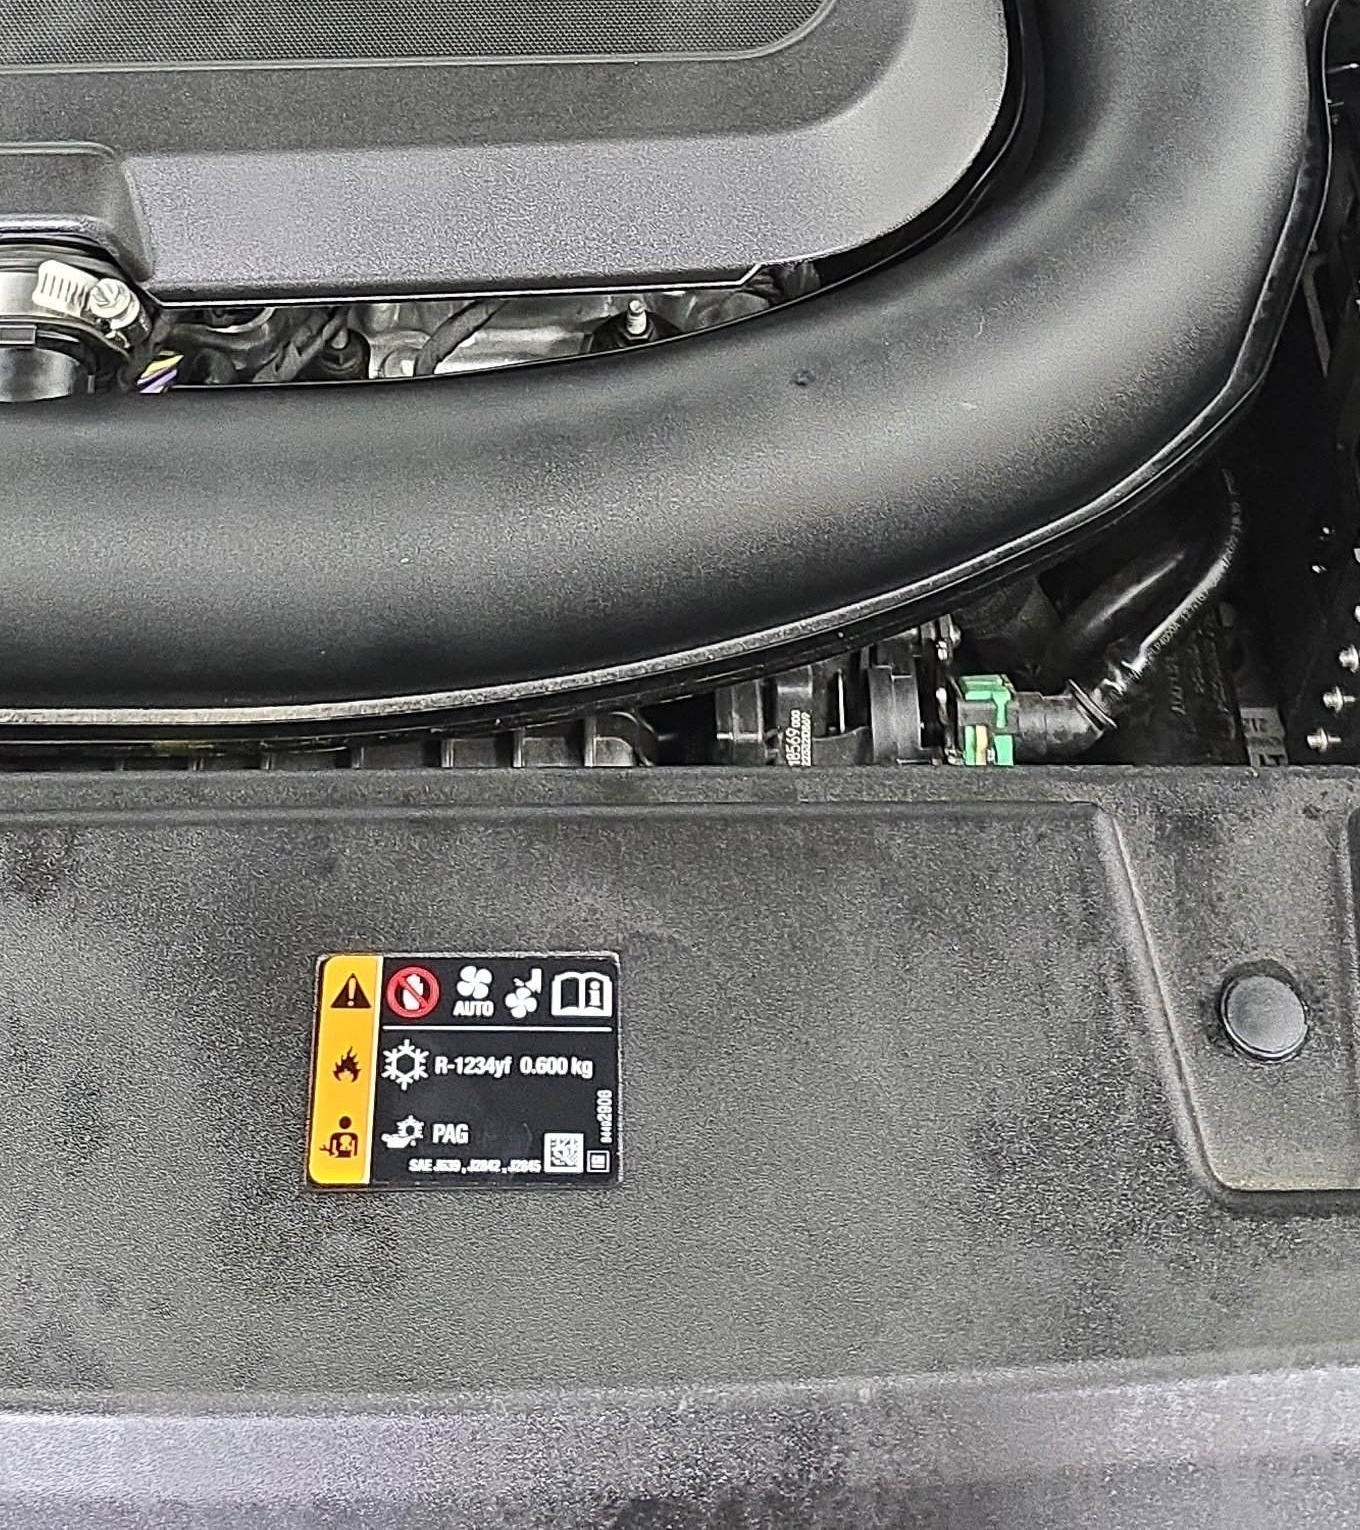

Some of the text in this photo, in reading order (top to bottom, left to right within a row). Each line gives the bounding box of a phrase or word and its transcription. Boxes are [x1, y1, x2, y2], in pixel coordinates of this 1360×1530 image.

[785, 727, 801, 766] 18569
[452, 1000, 495, 1018] AUTO
[434, 1056, 594, 1080] R-1234yf 0.600 kg
[432, 1123, 470, 1145] PAG
[408, 1158, 433, 1172] SAE
